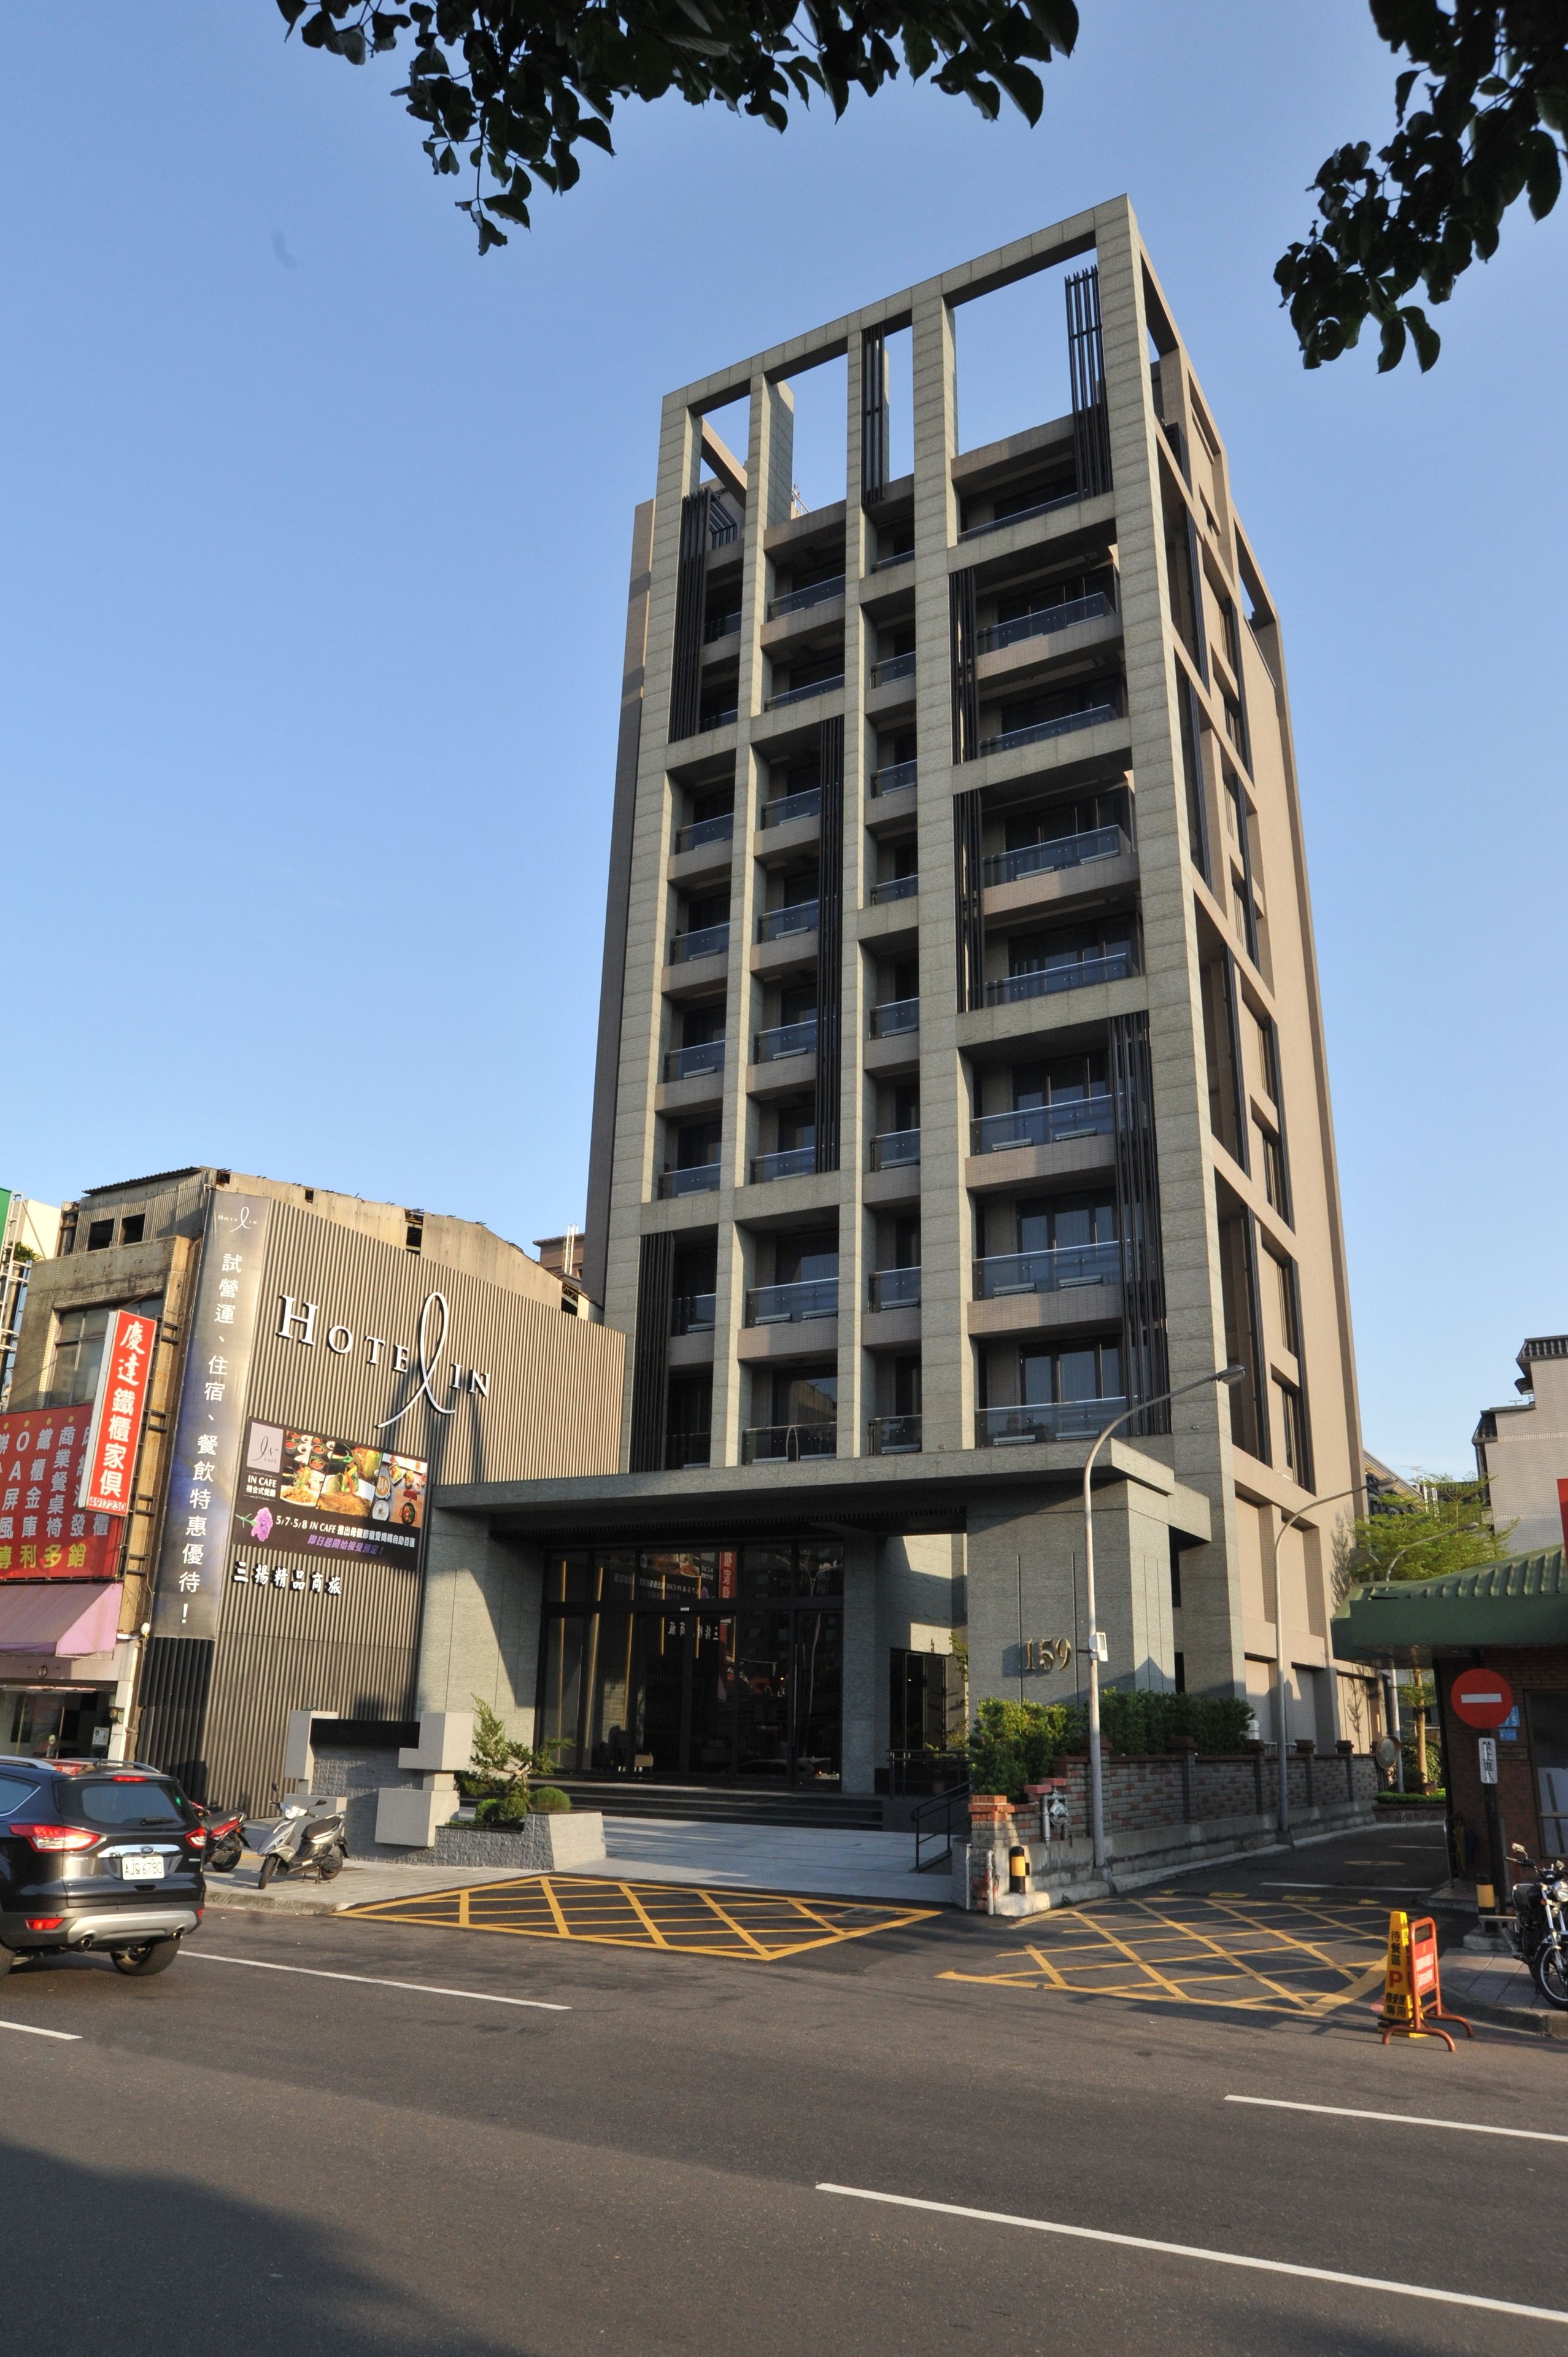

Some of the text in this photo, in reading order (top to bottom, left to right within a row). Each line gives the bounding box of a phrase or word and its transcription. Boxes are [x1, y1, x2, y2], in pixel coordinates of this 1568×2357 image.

[449, 1363, 491, 1398] IN
[247, 1474, 277, 1488] IN CAFE
[89, 1497, 126, 1512] 4917230
[309, 1520, 319, 1531] IN
[319, 1522, 337, 1534] CAFE
[233, 1561, 342, 1595] 三揚精品商旅
[1024, 1636, 1072, 1671] 159
[1389, 1970, 1404, 1988] P
